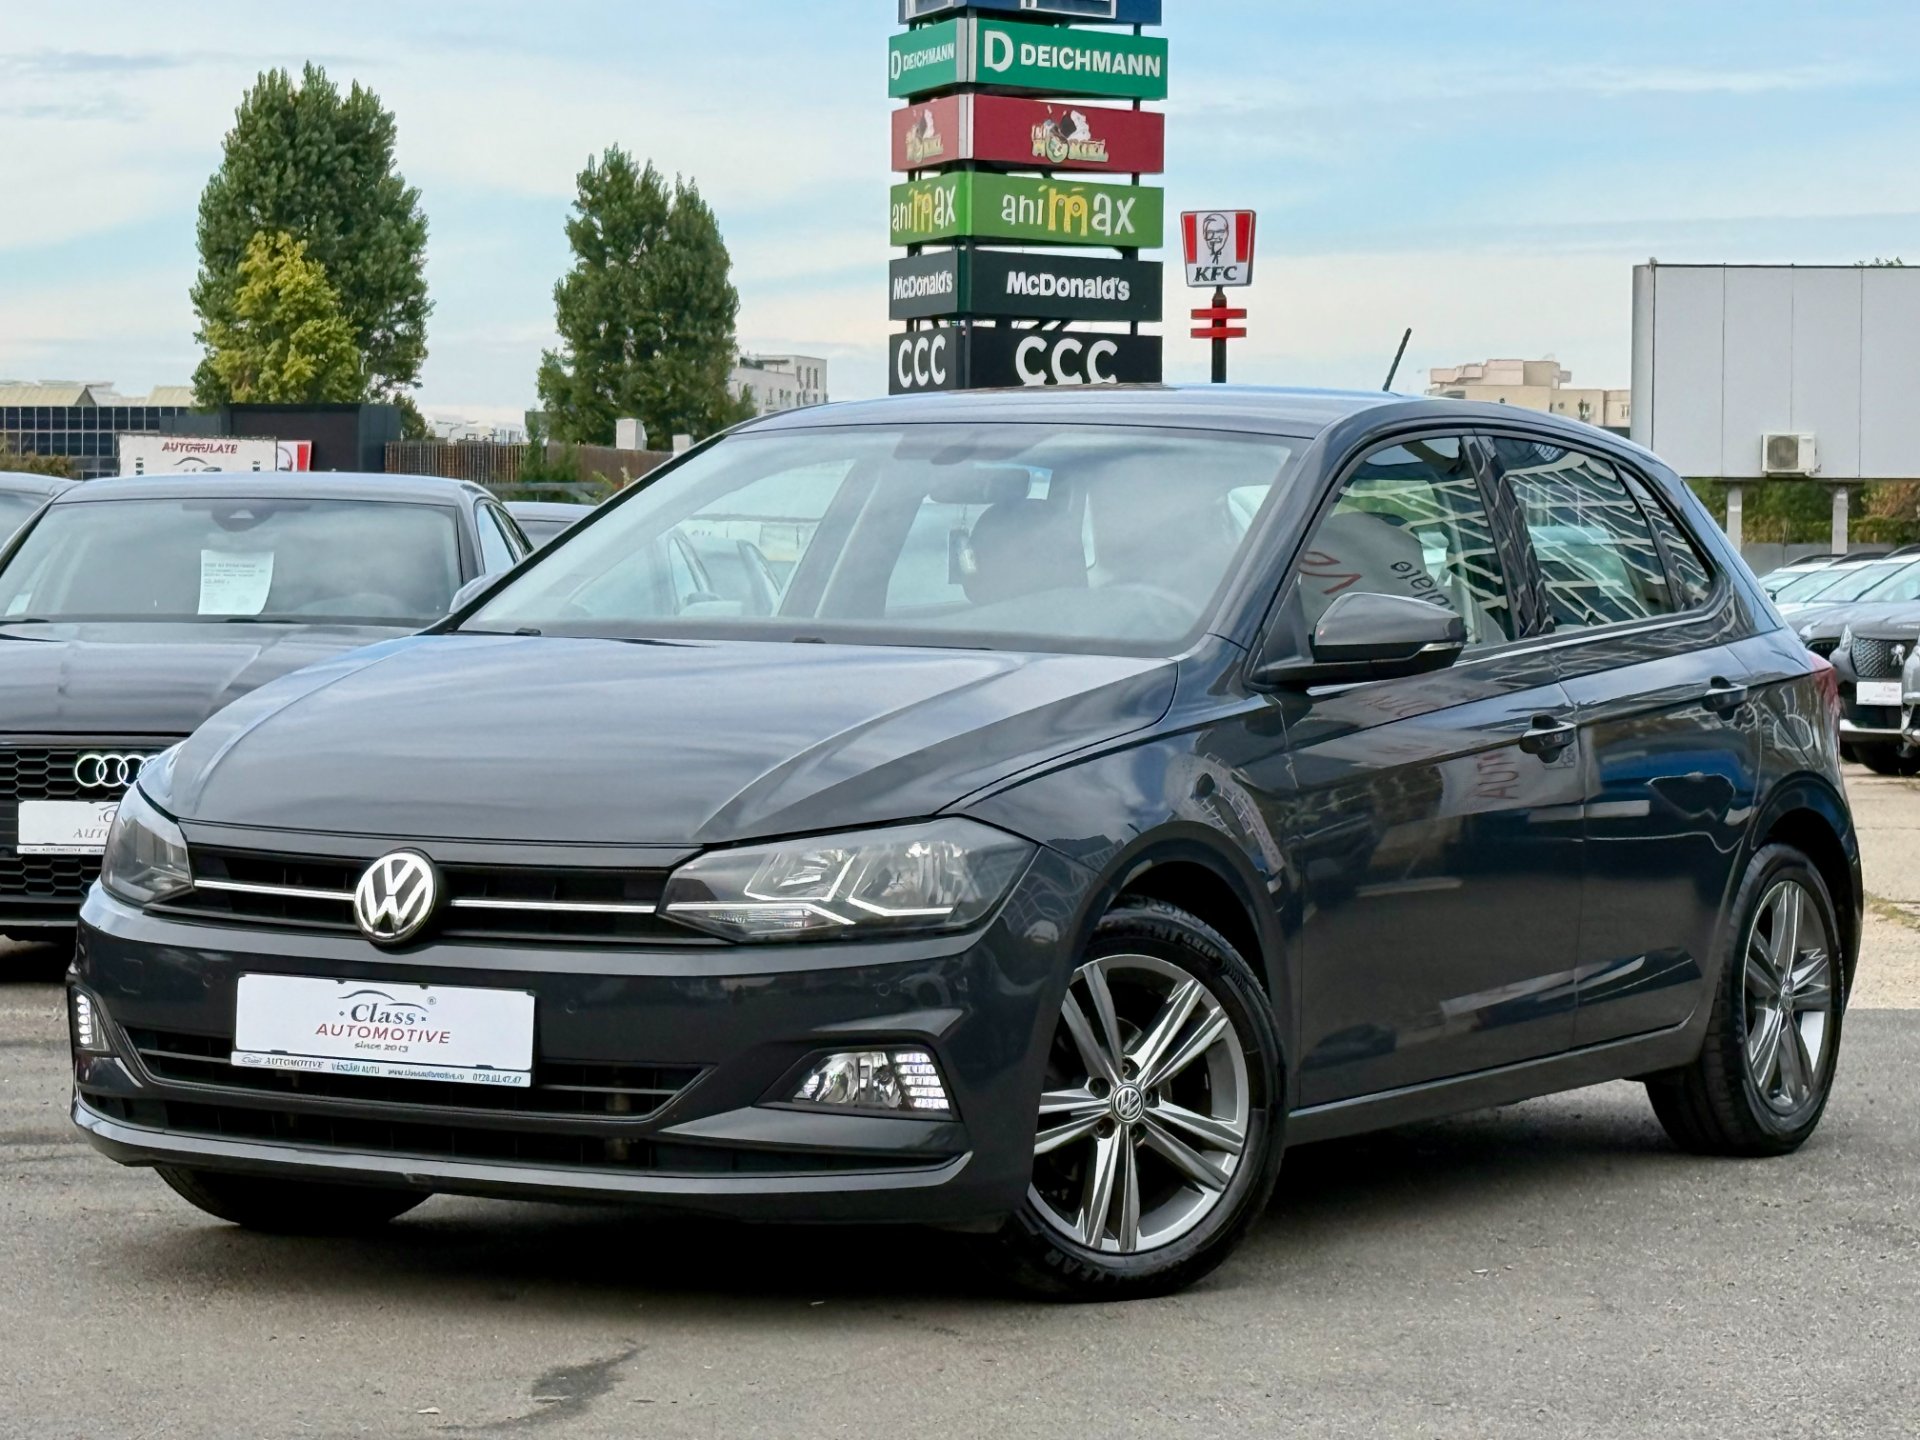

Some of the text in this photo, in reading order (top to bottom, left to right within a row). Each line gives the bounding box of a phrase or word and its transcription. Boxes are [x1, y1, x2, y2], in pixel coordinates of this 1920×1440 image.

[903, 43, 955, 71] DEICHMANN
[984, 30, 1161, 78] D DEICHMANN
[892, 184, 956, 233] animax
[1001, 188, 1136, 237] animax
[893, 270, 953, 300] McDonald's
[1006, 271, 1130, 301] McDonald's
[1193, 266, 1238, 282] KFC
[897, 334, 946, 389] CCC
[1015, 335, 1118, 386] CCC
[351, 1002, 416, 1026] Class
[315, 1023, 451, 1044] AUTOMOTIVE
[354, 1041, 409, 1053] since 2013
[265, 1057, 324, 1069] AUTOMOTIVE
